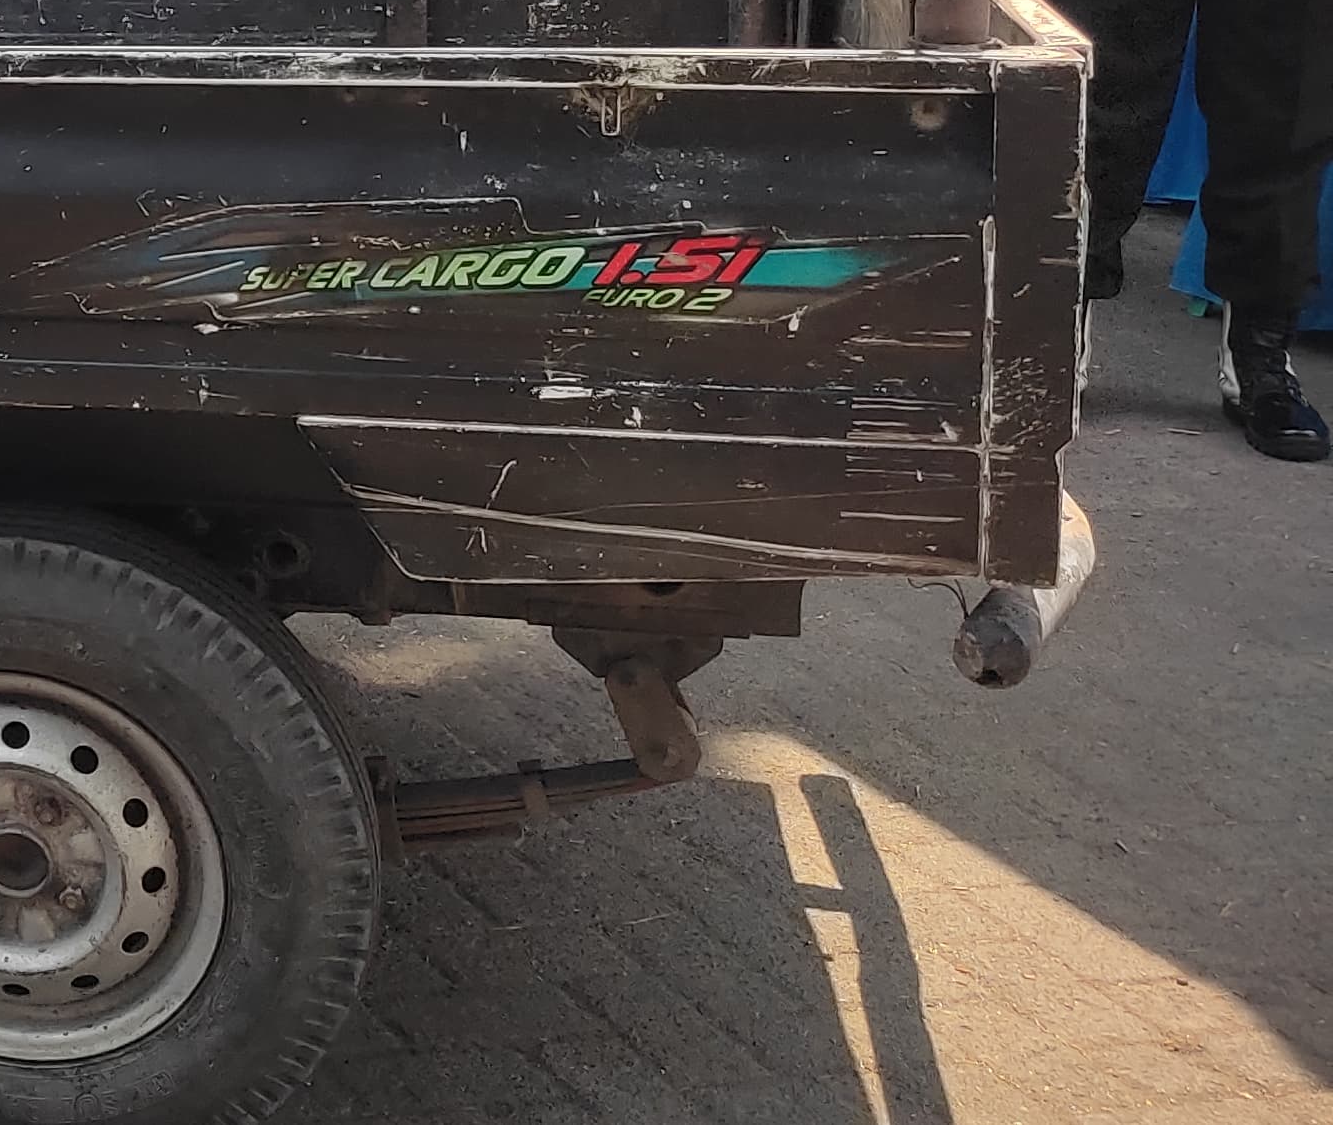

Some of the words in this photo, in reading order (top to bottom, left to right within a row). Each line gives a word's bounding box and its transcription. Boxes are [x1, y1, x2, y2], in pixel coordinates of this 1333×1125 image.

[239, 259, 367, 292] SUPER
[369, 246, 586, 289] CARGO
[583, 287, 686, 309] EURO
[682, 287, 734, 311] 2
